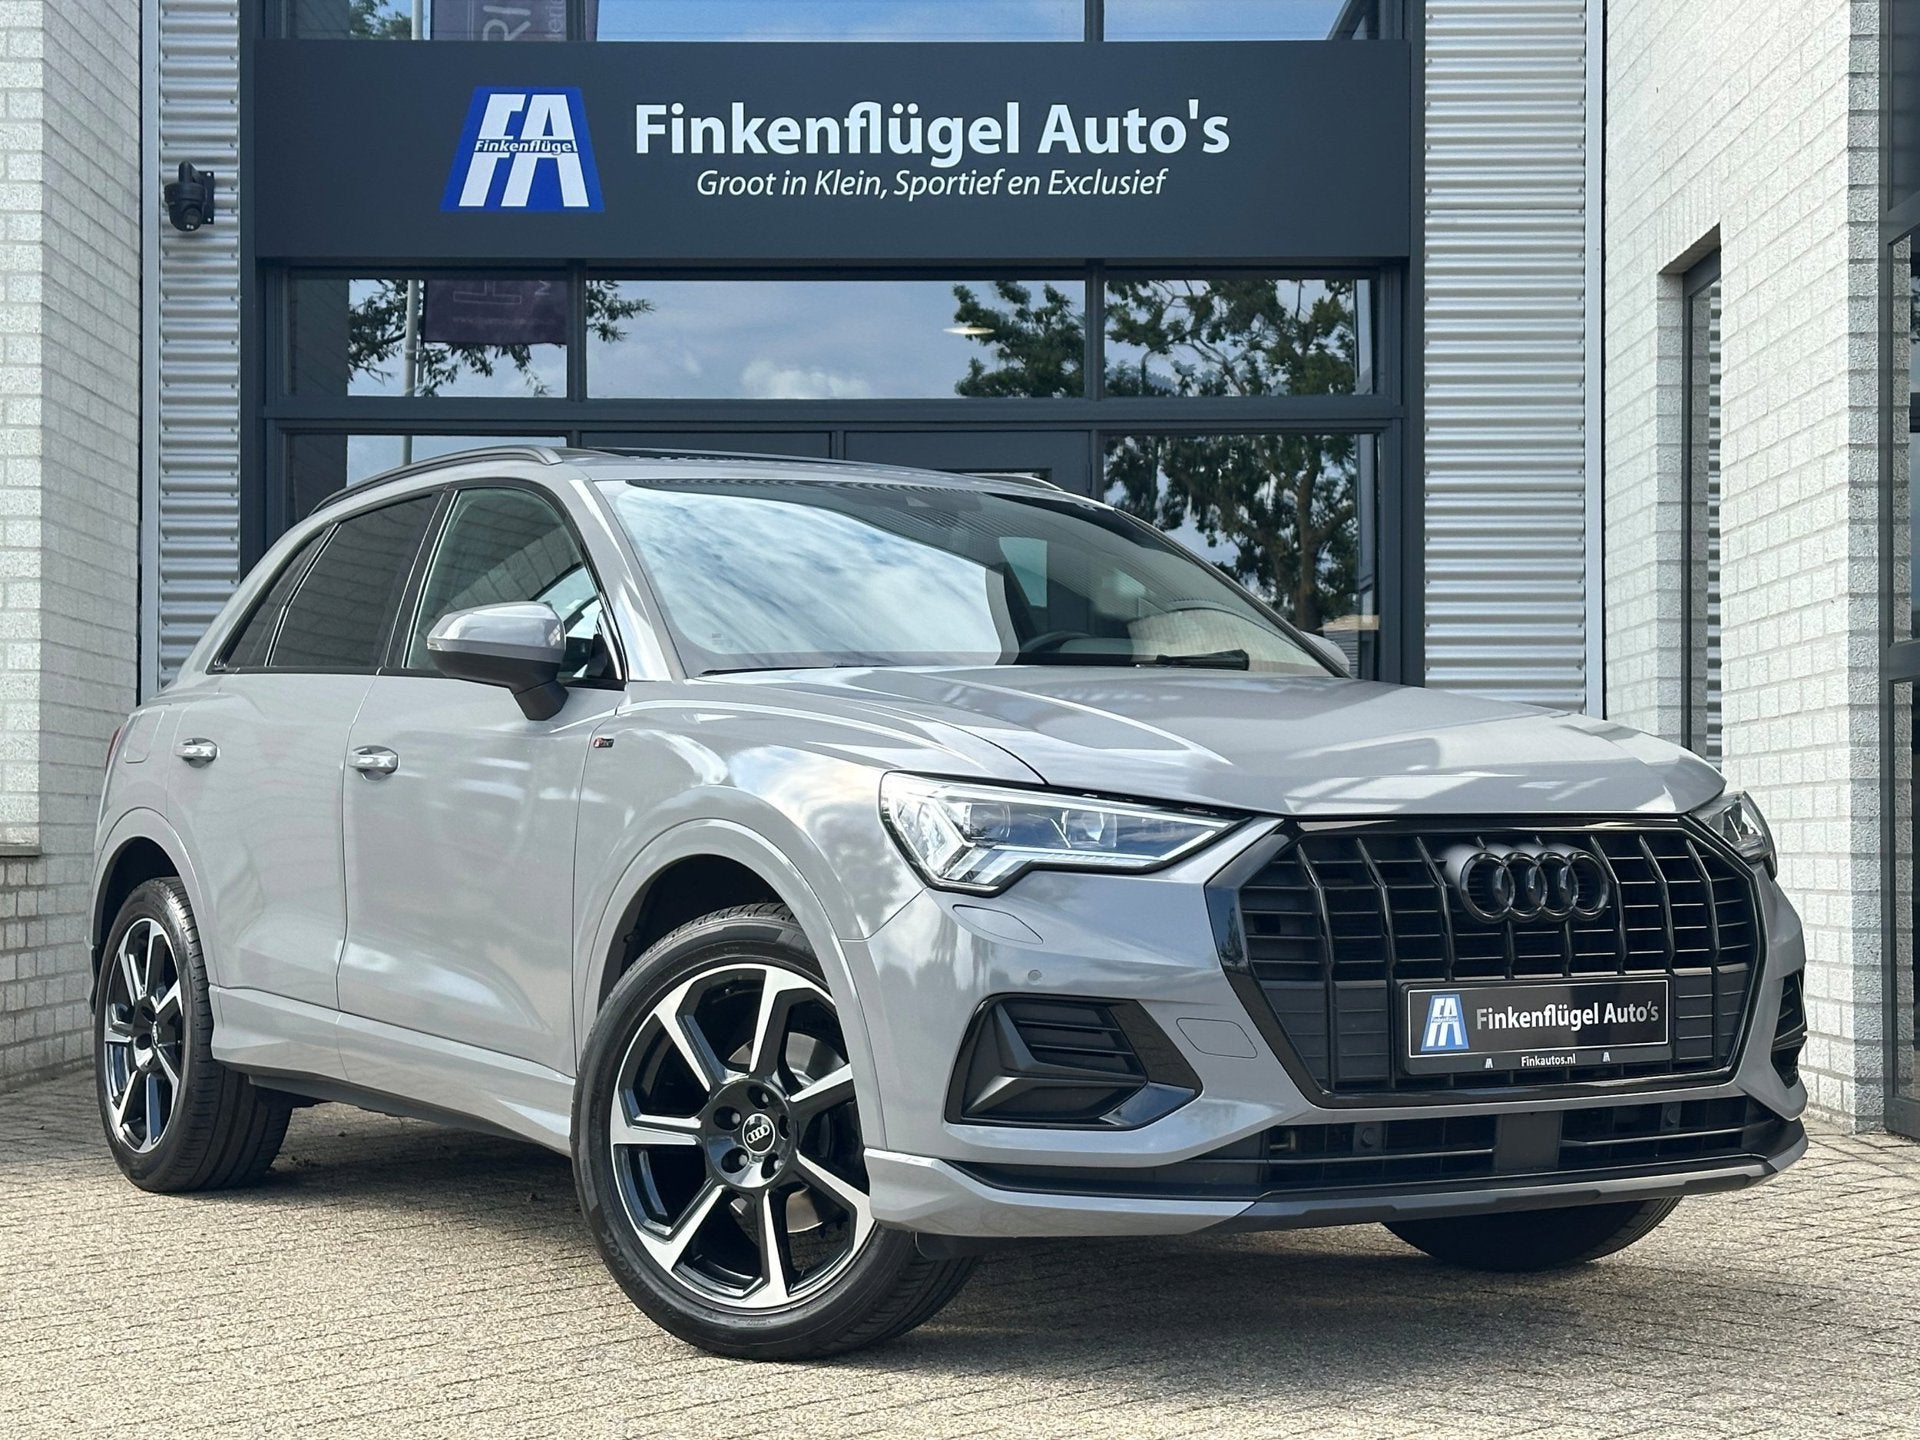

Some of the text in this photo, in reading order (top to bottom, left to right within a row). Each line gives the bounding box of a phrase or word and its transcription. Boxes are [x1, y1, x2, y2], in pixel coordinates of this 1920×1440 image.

[475, 140, 578, 154] Finkenflügel
[636, 99, 1229, 168] Finkenflügel Auto's
[459, 94, 589, 206] FA
[697, 168, 1169, 201] Groot in Klein, Sportief en Exclusief
[1476, 1002, 1599, 1032] Finkenflügel
[1521, 1053, 1576, 1067] Finkautos.nl
